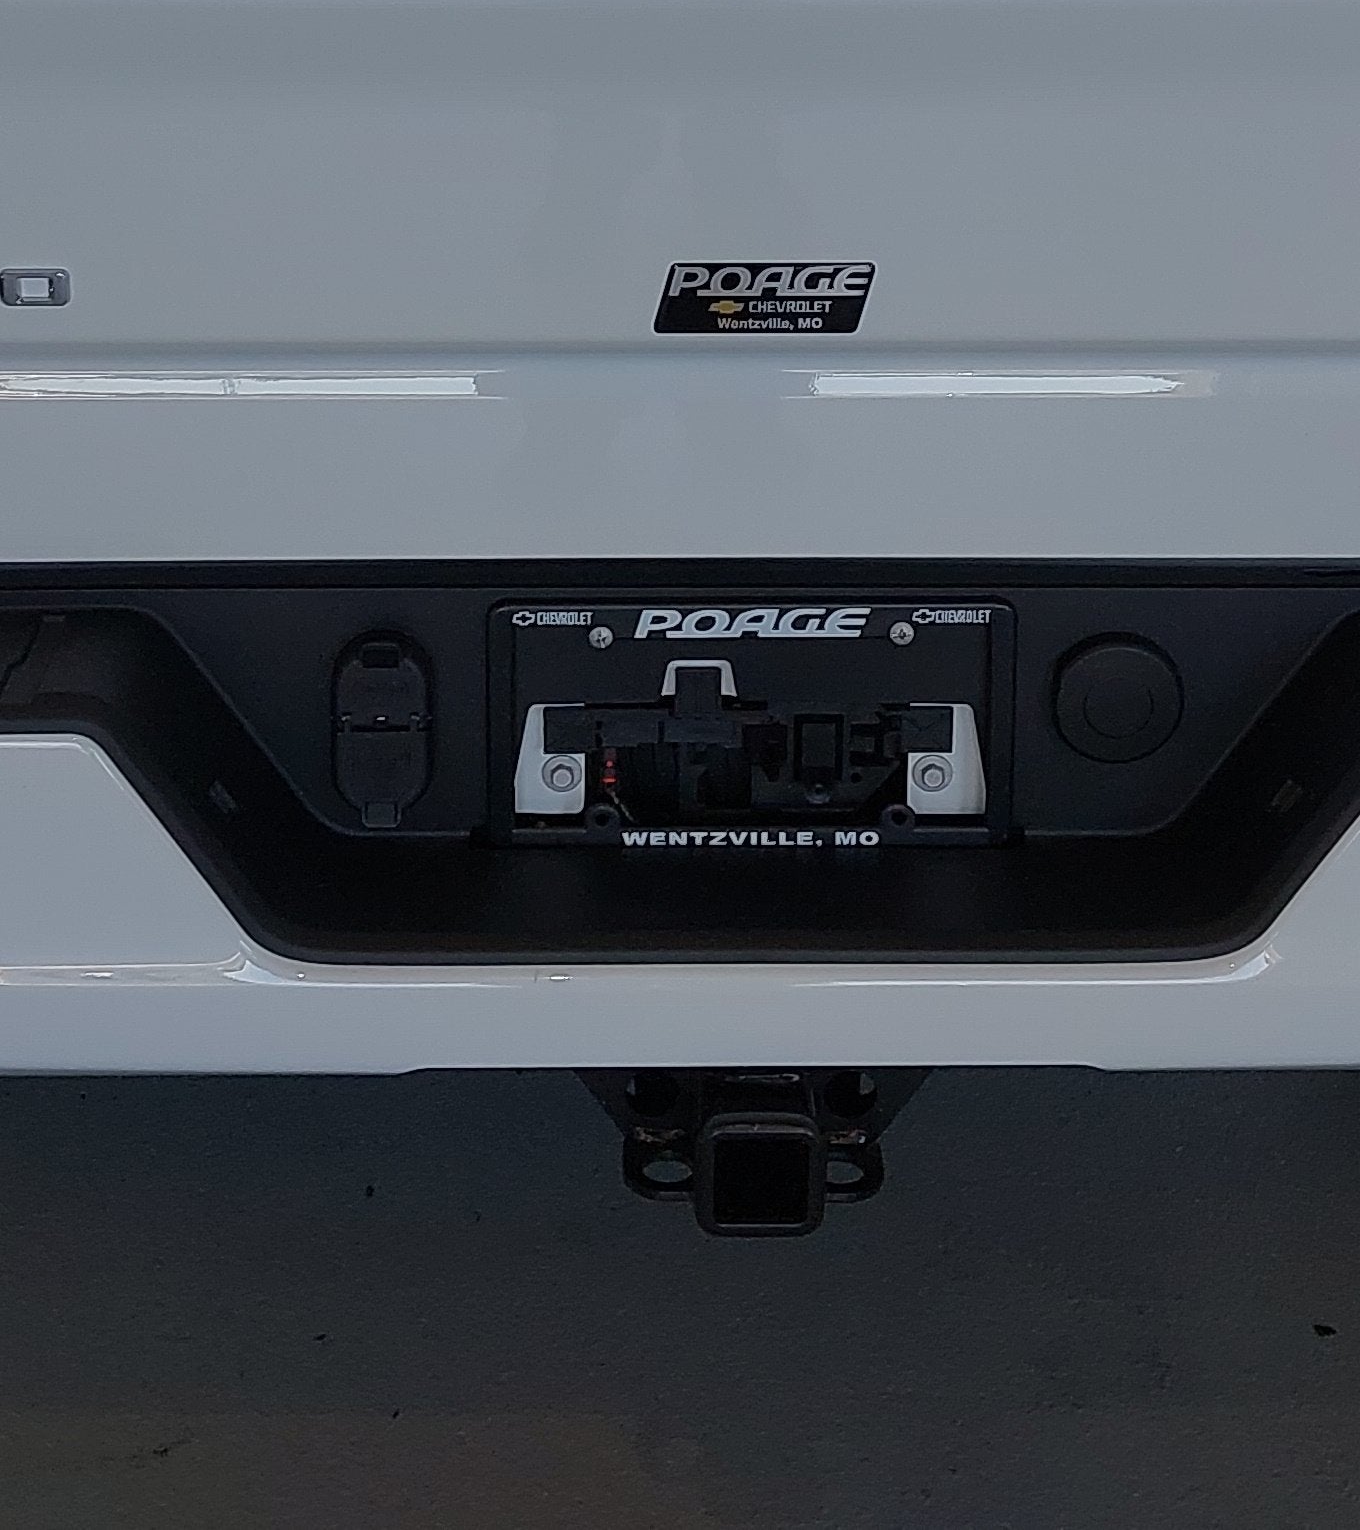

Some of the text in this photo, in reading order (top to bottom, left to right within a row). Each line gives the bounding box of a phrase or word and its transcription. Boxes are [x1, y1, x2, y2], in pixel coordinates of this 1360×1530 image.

[668, 265, 872, 297] POAGE
[748, 300, 833, 313] CHEVROLET
[797, 317, 823, 329] MO
[536, 611, 593, 626] CHEVROLET
[633, 607, 872, 639] POAGE
[934, 609, 991, 624] CHEVROLET
[621, 831, 880, 847] WENTZVILLE, MO
